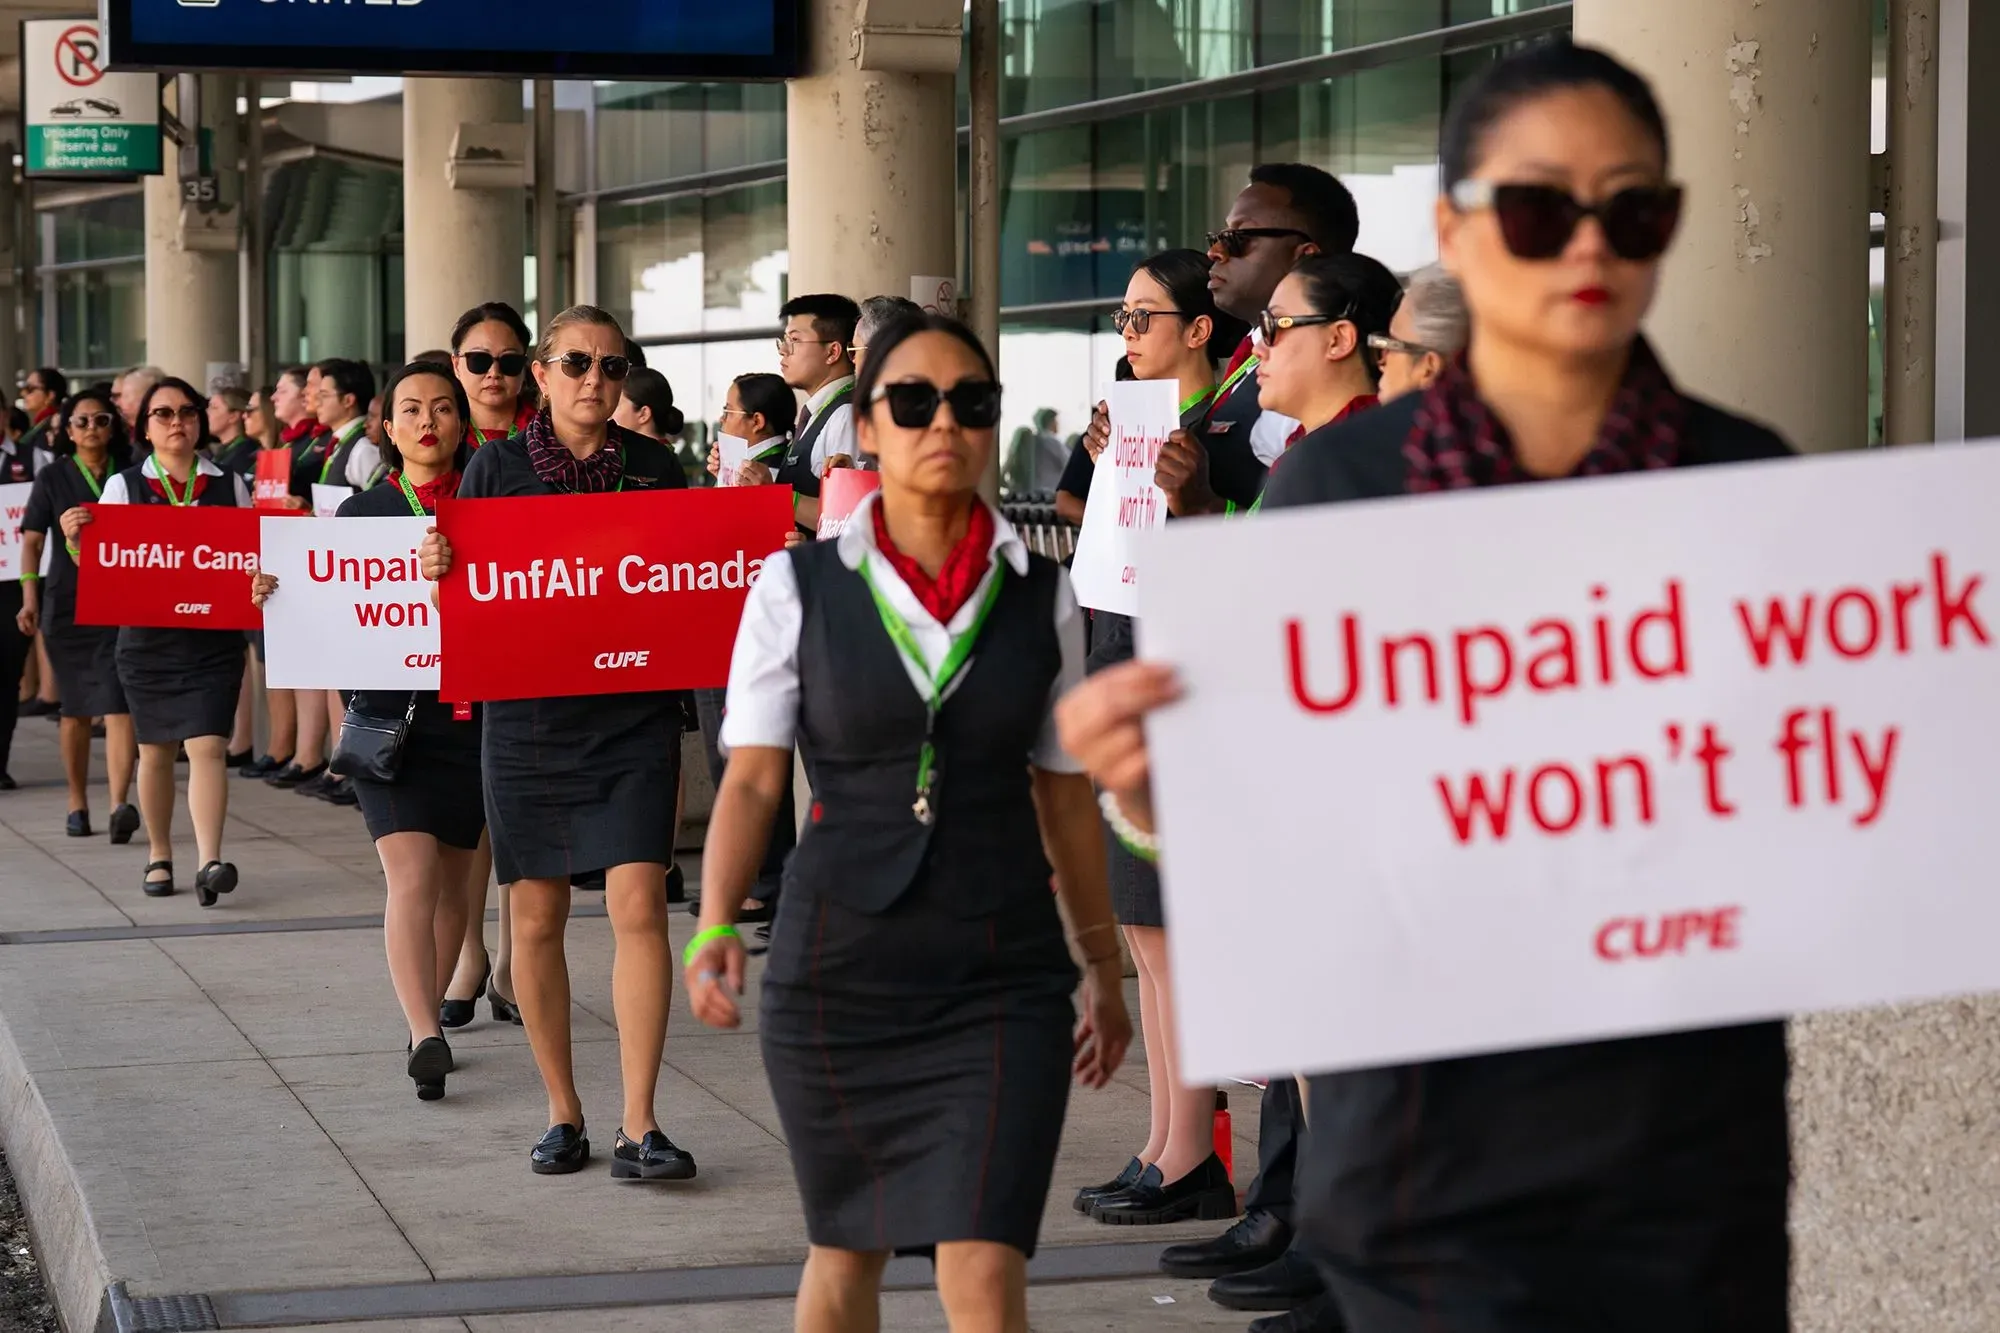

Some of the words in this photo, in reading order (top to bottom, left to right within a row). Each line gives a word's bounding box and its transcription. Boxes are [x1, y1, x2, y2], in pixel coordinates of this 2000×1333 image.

[100, 126, 130, 140] Only
[101, 143, 118, 152] au
[185, 181, 215, 200] 35
[1116, 424, 1146, 478] Unpaid
[1118, 485, 1144, 530] won't
[98, 542, 185, 568] UnfAir
[192, 544, 260, 570] Cana
[308, 548, 436, 590] Unpai
[466, 557, 604, 602] UnfAir
[174, 603, 212, 615] CUPE
[1284, 578, 1691, 724] Unpaid
[1733, 550, 1993, 669] work
[594, 650, 650, 669] CUPE
[1435, 721, 1738, 847] won't
[1776, 705, 1901, 828] fly
[1593, 905, 1742, 963] CUPE
